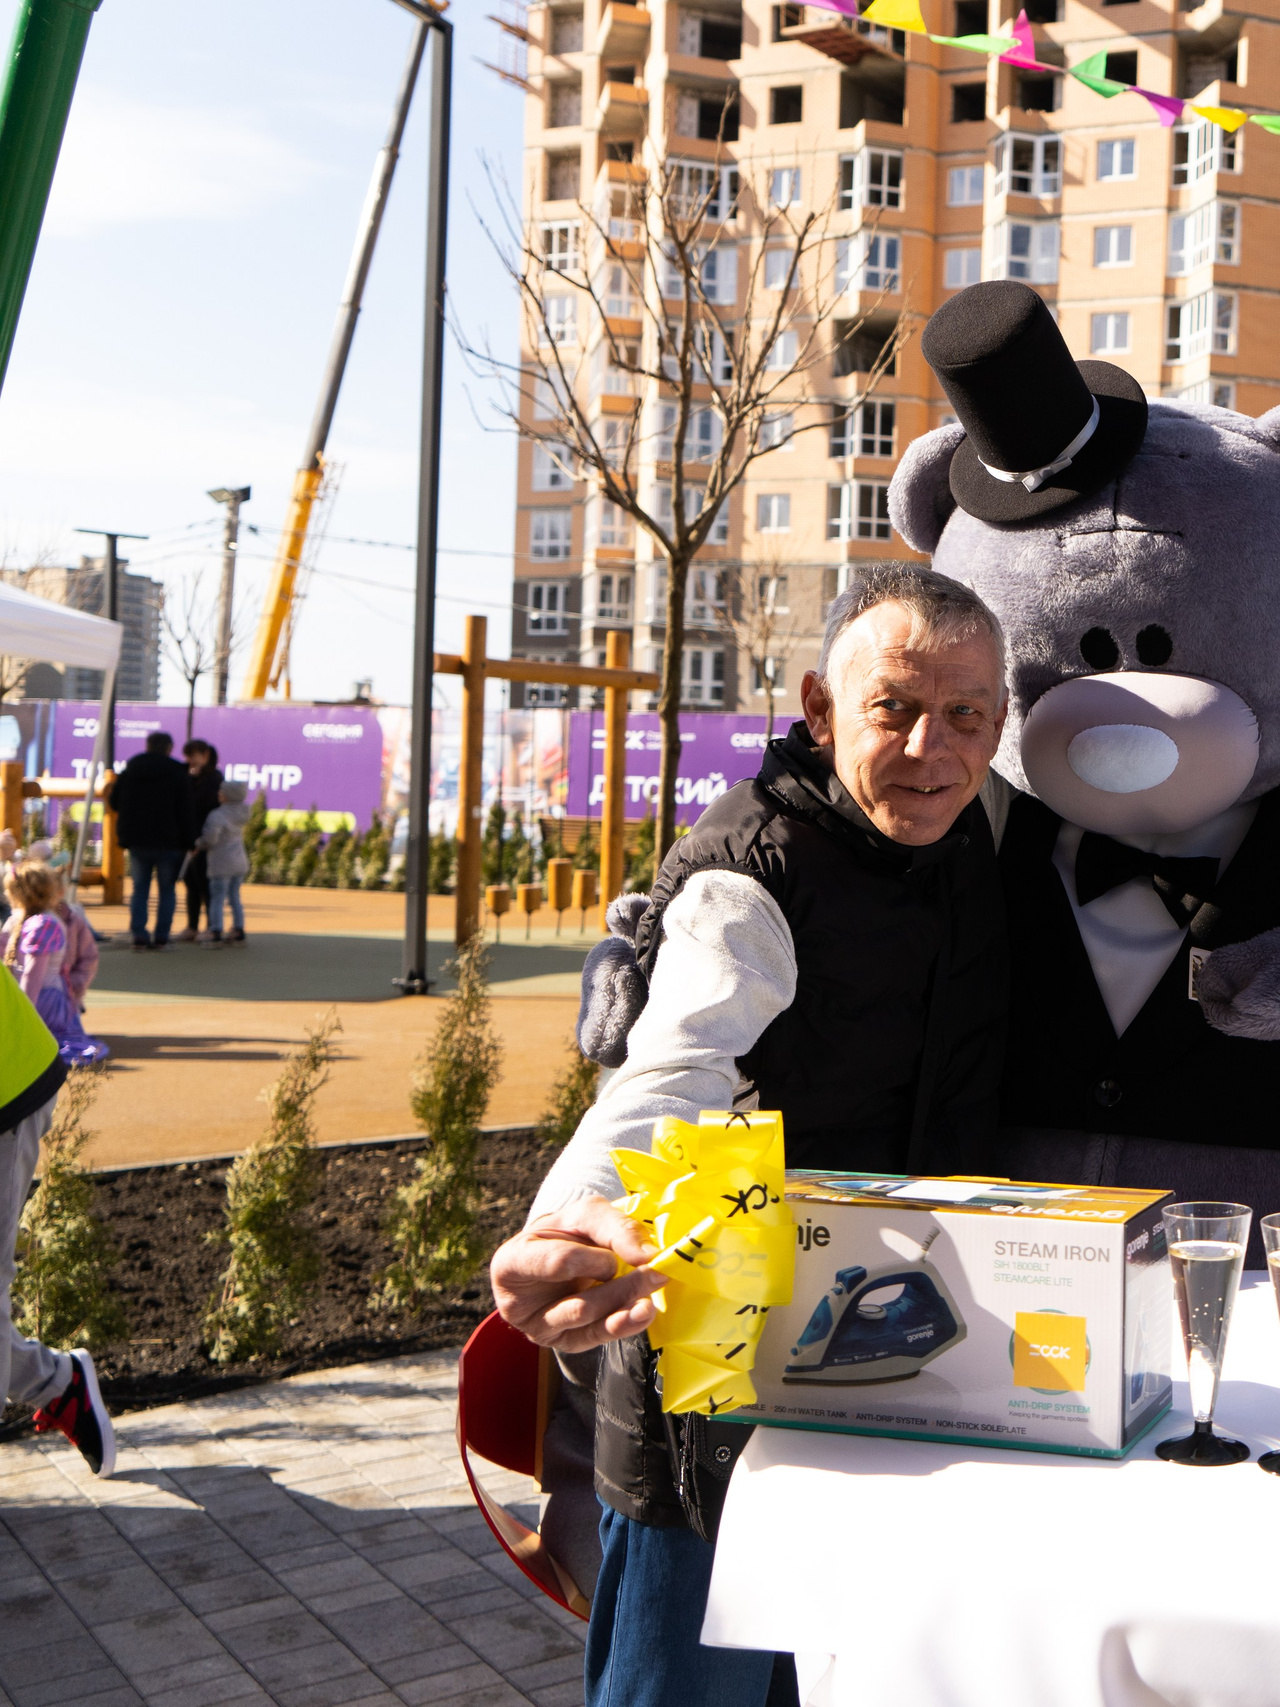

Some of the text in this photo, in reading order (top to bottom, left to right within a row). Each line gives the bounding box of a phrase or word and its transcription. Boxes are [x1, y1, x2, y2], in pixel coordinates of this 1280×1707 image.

[994, 1240, 1110, 1263] STEAM IRON
[994, 1272, 1052, 1286] STEAMCARE
[1008, 1400, 1090, 1414] ANTI-DRIP SYSTEM
[774, 1405, 786, 1414] 250
[798, 1407, 825, 1417] WATER
[827, 1410, 848, 1419] TANK
[856, 1412, 894, 1423] ANTI-DRIP
[895, 1416, 928, 1426] SYSTEM
[936, 1419, 979, 1431] NON-STICK
[980, 1423, 1027, 1435] SOLEPLATE
